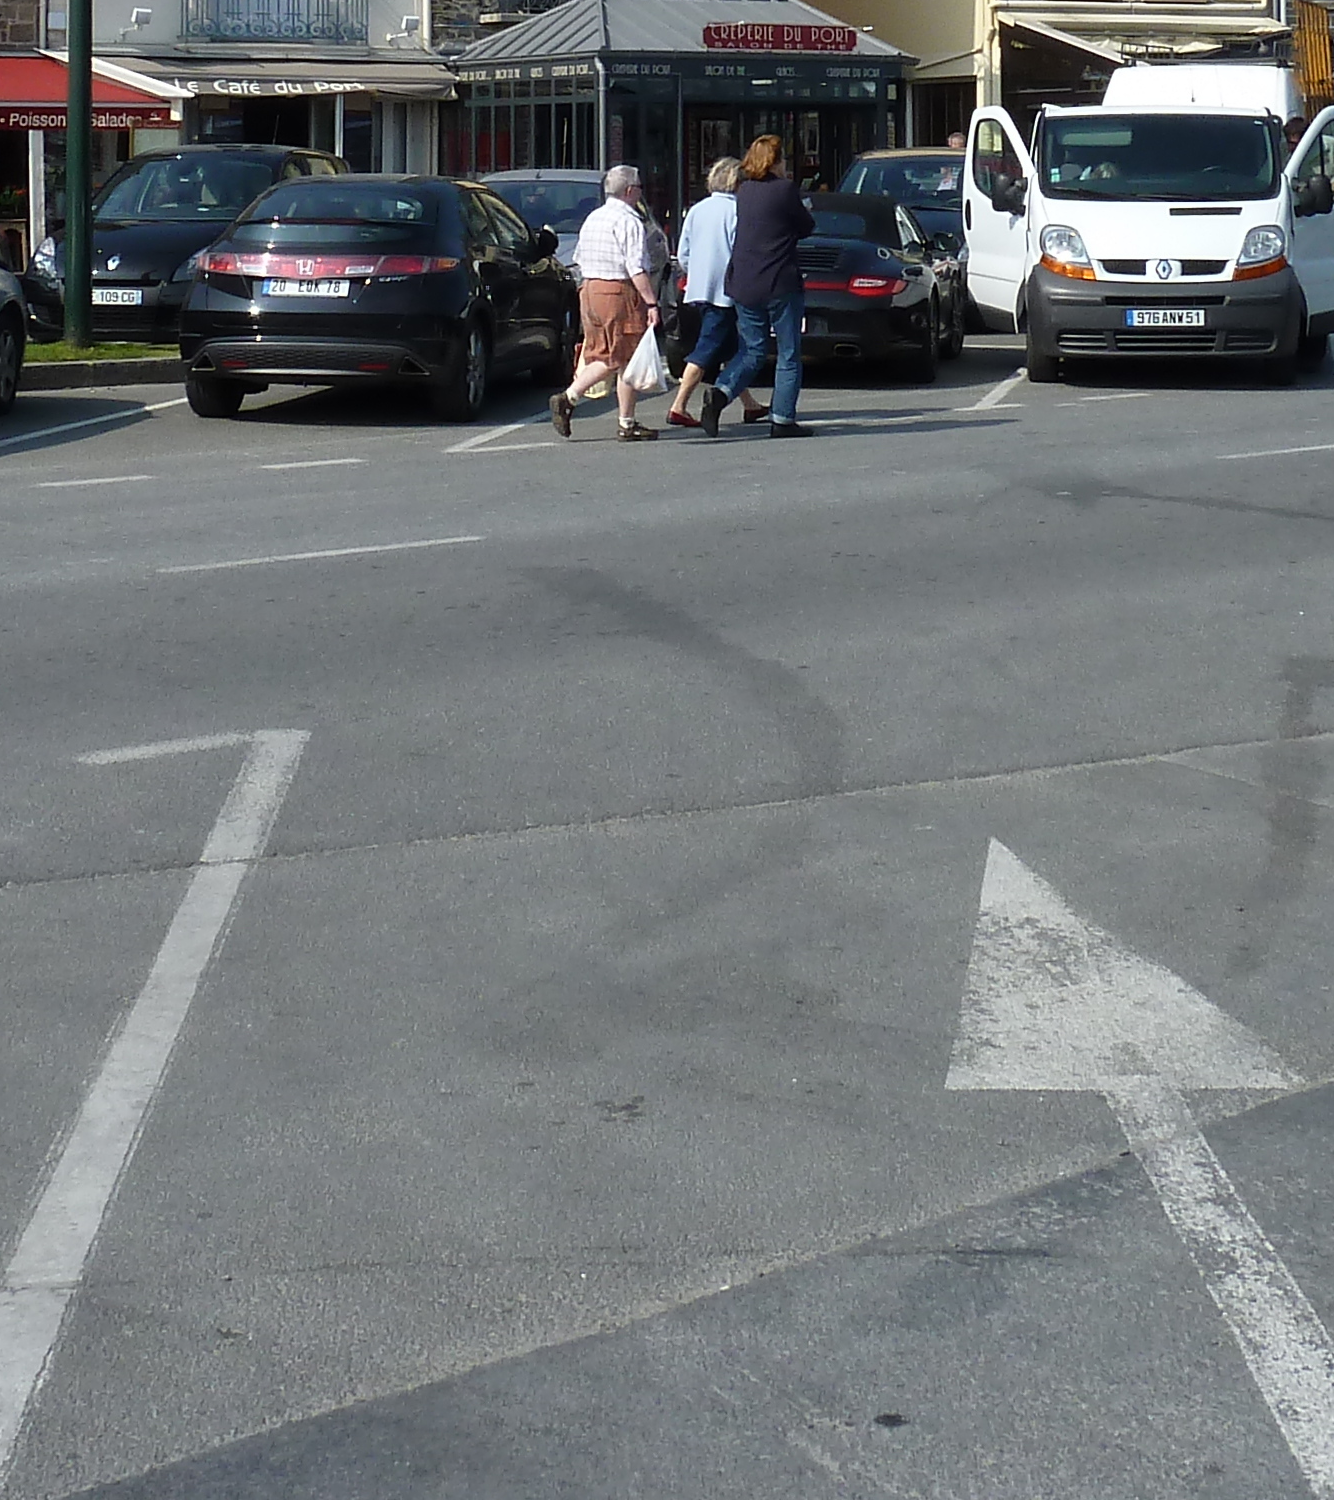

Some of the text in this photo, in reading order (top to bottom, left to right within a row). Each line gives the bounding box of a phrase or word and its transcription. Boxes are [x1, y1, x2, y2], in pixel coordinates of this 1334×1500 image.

[711, 24, 849, 43] CREPERIE DU PORT
[174, 77, 199, 92] Le
[213, 78, 262, 95] Café
[274, 80, 304, 94] du
[271, 279, 287, 293] 20
[326, 281, 341, 294] 78
[100, 290, 119, 303] 109
[1137, 311, 1160, 324] 976
[1185, 311, 1200, 324] 51
